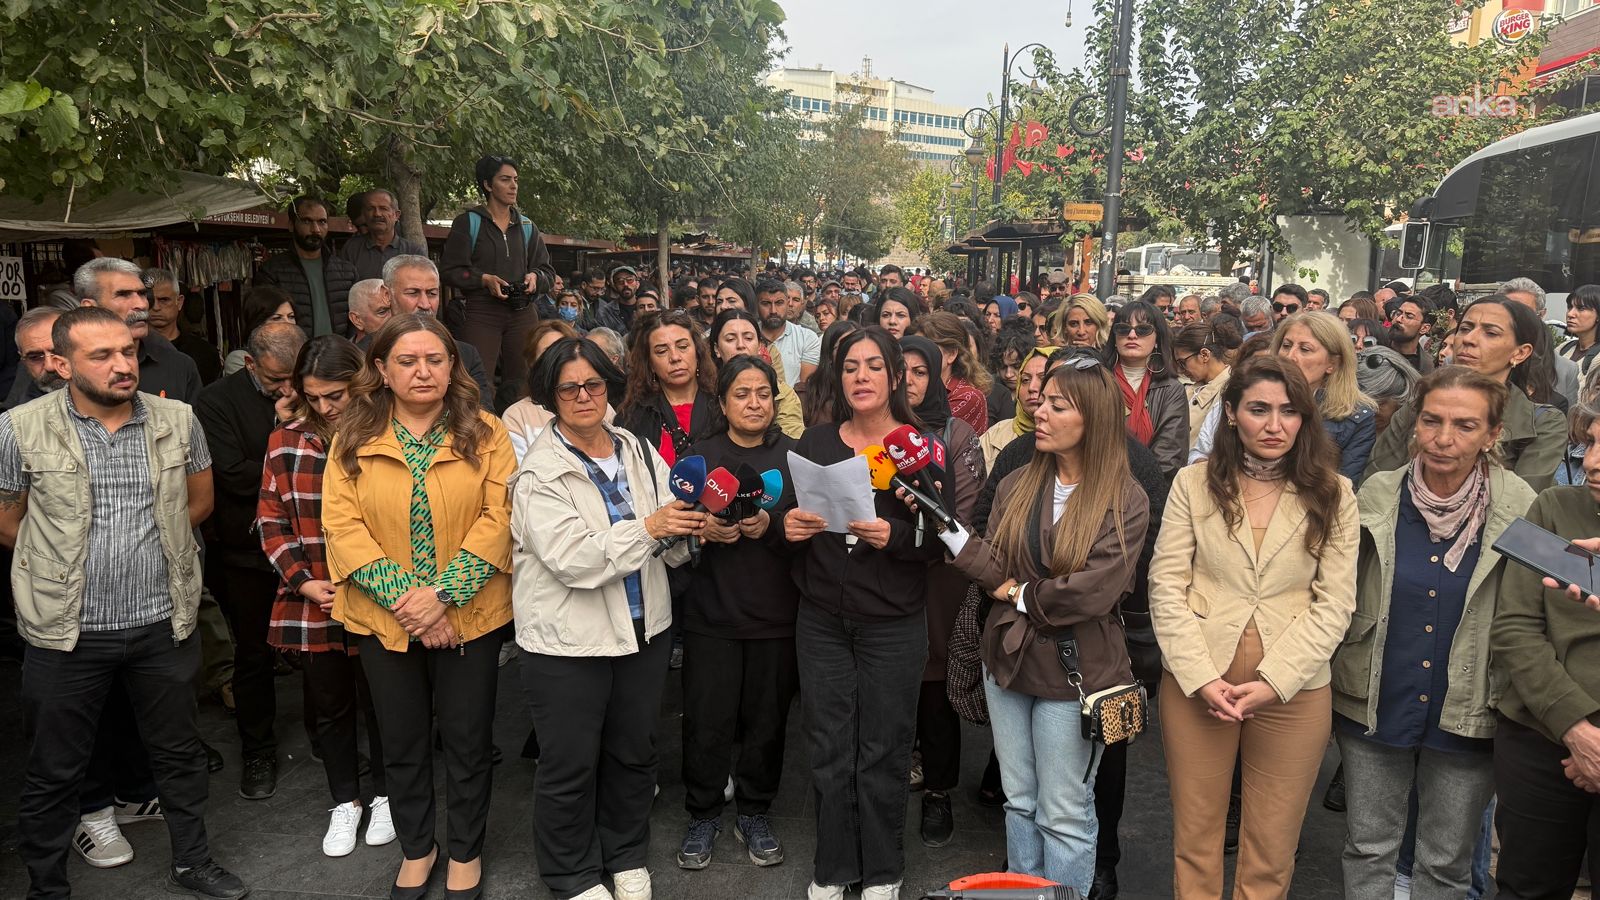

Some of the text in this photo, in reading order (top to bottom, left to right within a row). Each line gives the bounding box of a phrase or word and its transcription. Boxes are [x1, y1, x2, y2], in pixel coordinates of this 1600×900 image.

[1499, 13, 1530, 28] BURGER
[1500, 19, 1531, 35] KING
[896, 456, 916, 468] anka
[706, 478, 728, 502] DHA
